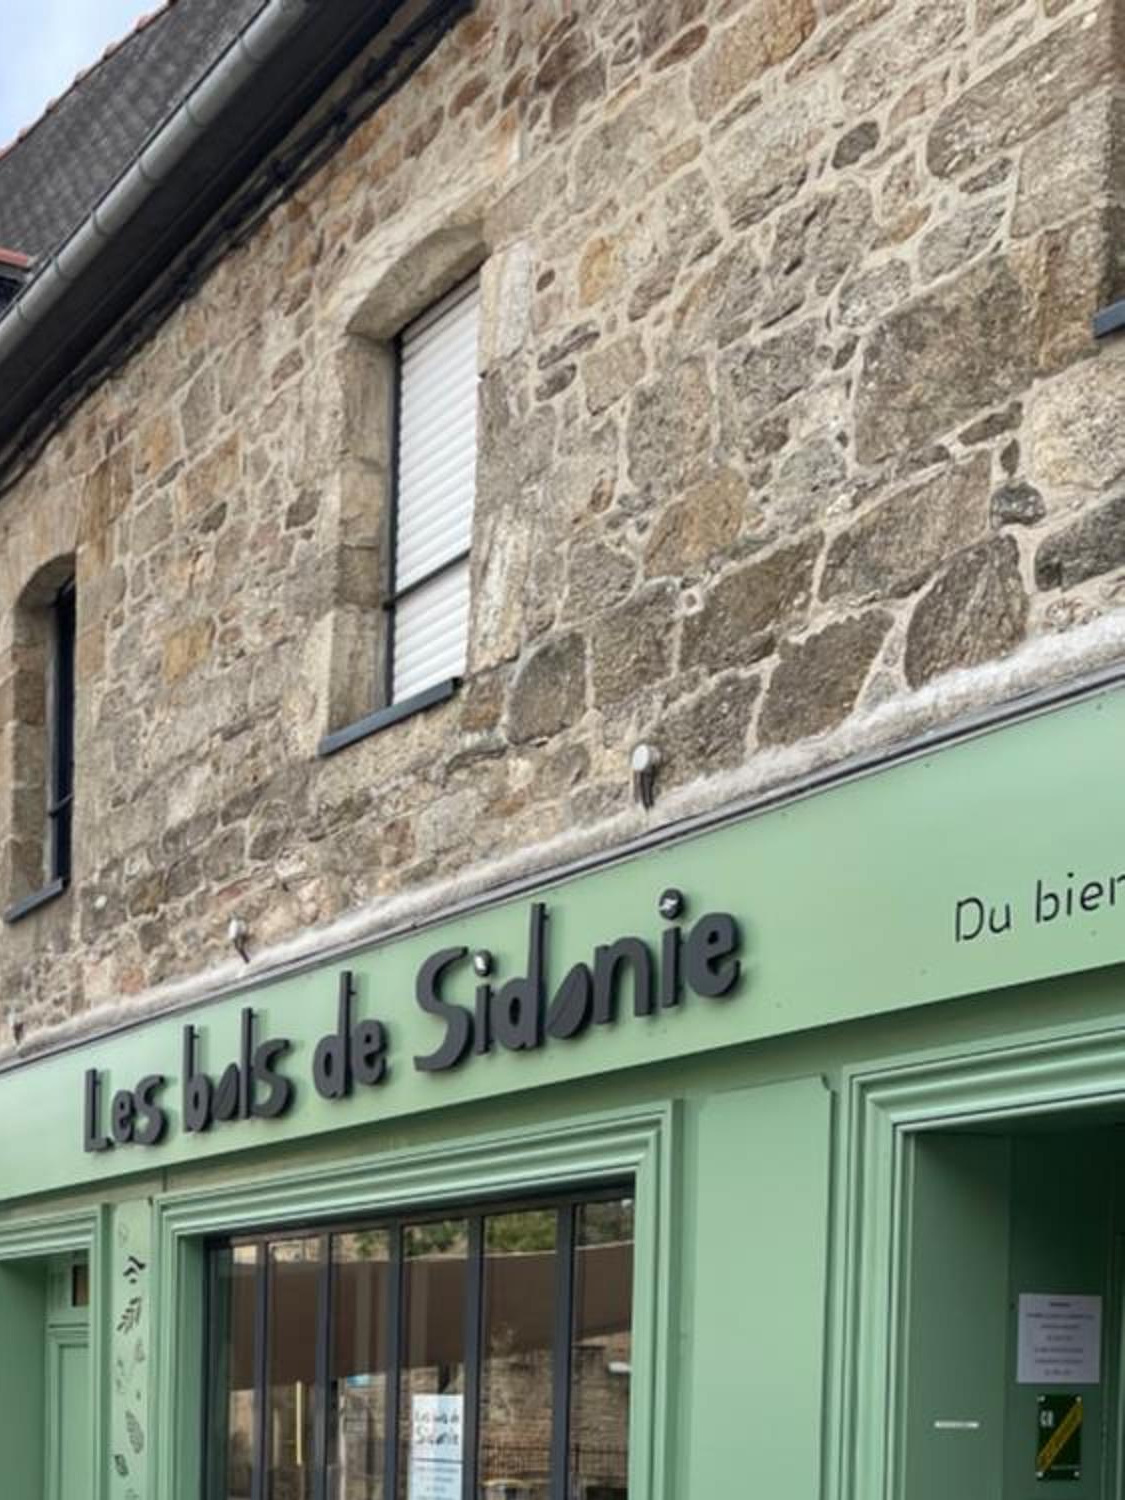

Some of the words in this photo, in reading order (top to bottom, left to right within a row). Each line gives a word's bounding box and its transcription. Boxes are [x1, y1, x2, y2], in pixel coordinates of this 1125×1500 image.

[955, 897, 1011, 943] Du
[83, 1067, 166, 1152] Les
[182, 1006, 297, 1133] bols
[312, 970, 389, 1100] de
[414, 888, 743, 1074] Sidonie
